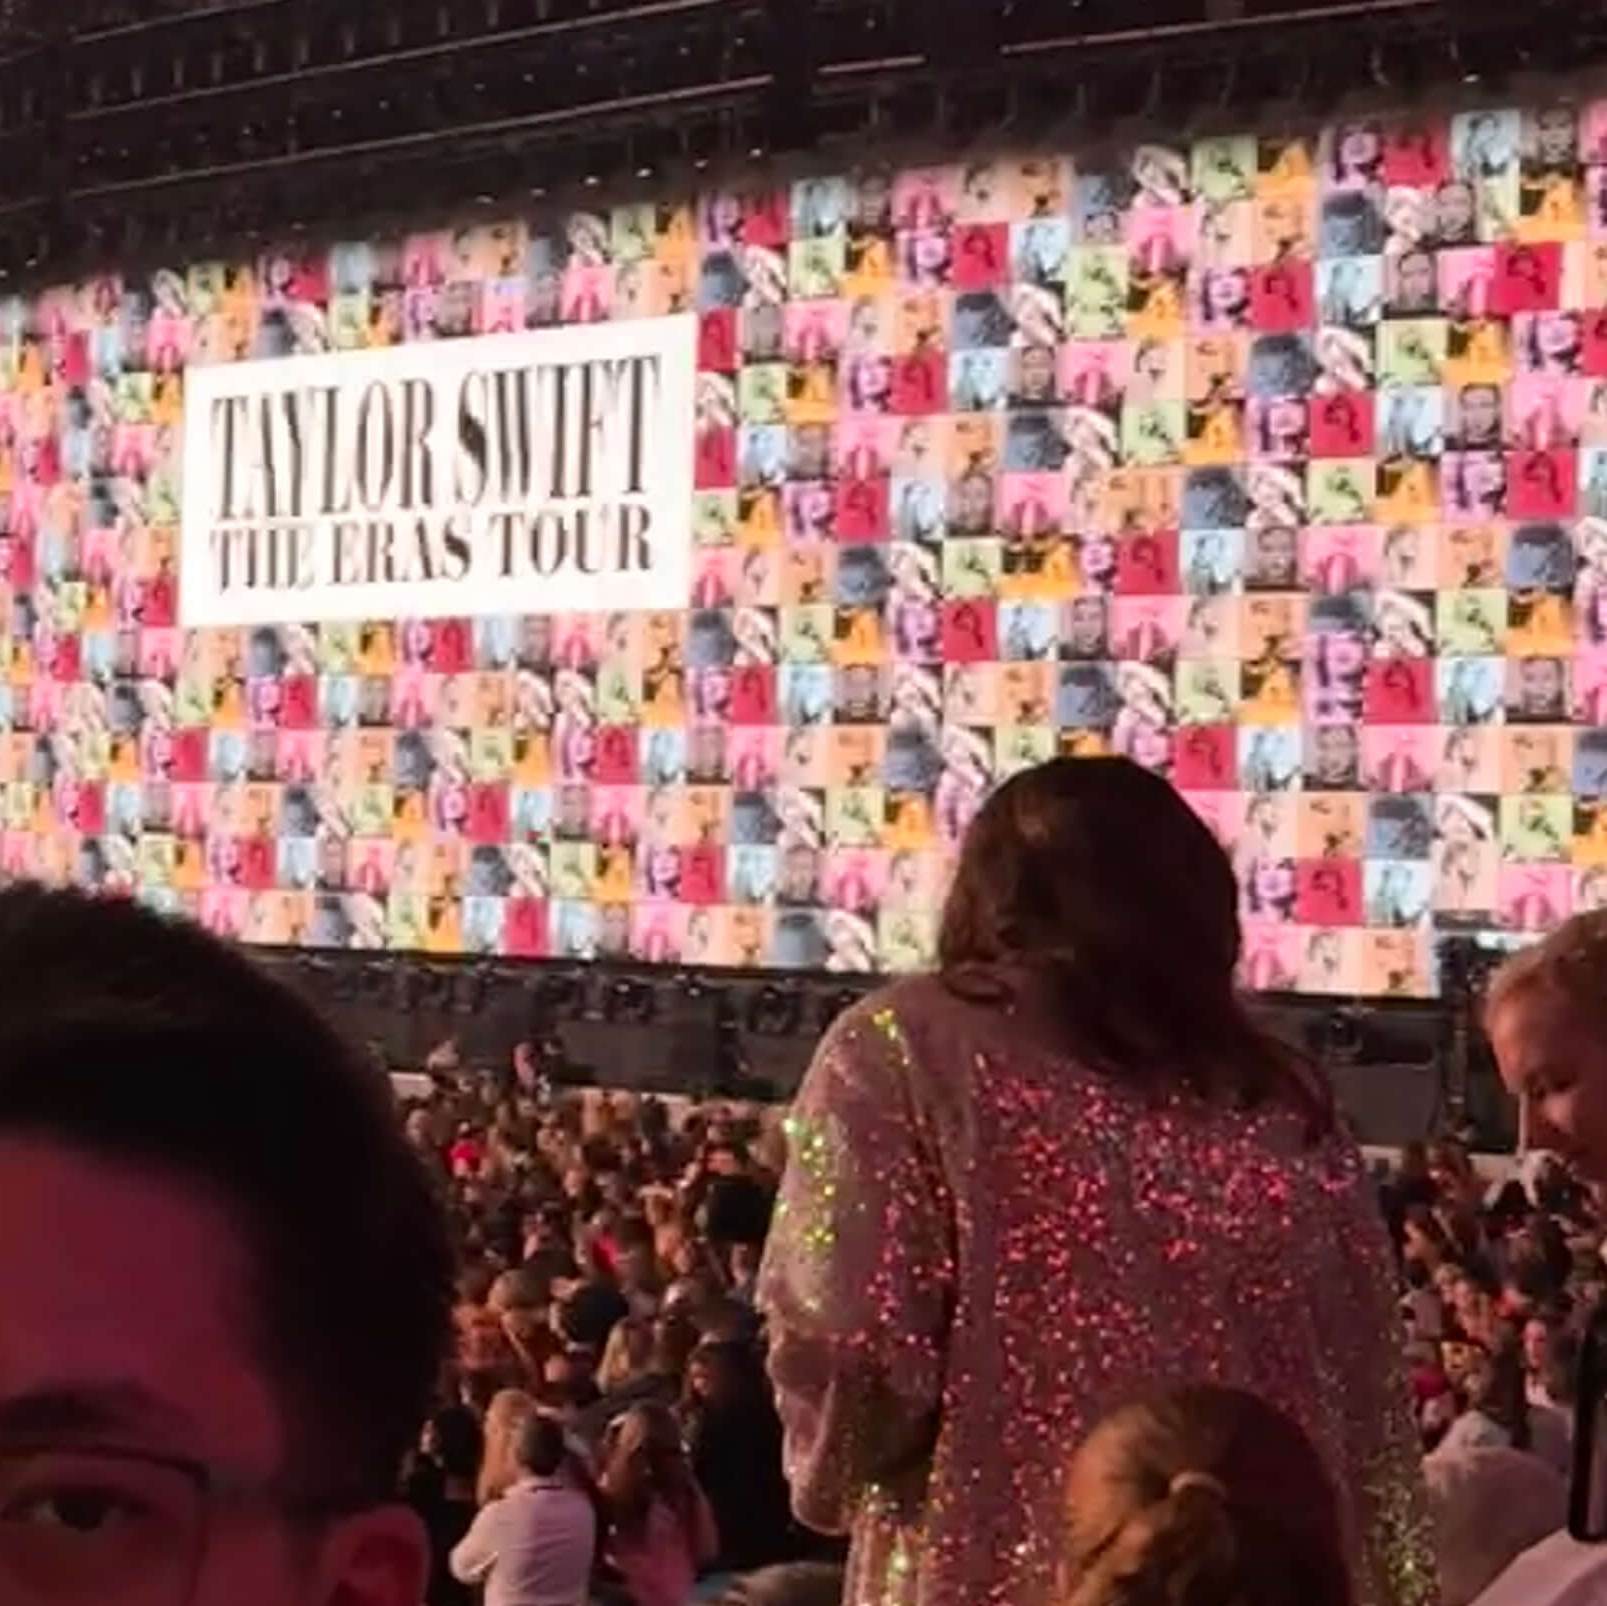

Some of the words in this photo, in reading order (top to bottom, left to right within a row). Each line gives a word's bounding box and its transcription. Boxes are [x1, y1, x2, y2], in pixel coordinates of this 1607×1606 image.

[211, 379, 435, 521] TAYLOR
[454, 353, 661, 509] SWIFT
[210, 522, 315, 594] THE
[328, 511, 472, 586] ERAS
[490, 504, 653, 579] TOUR
